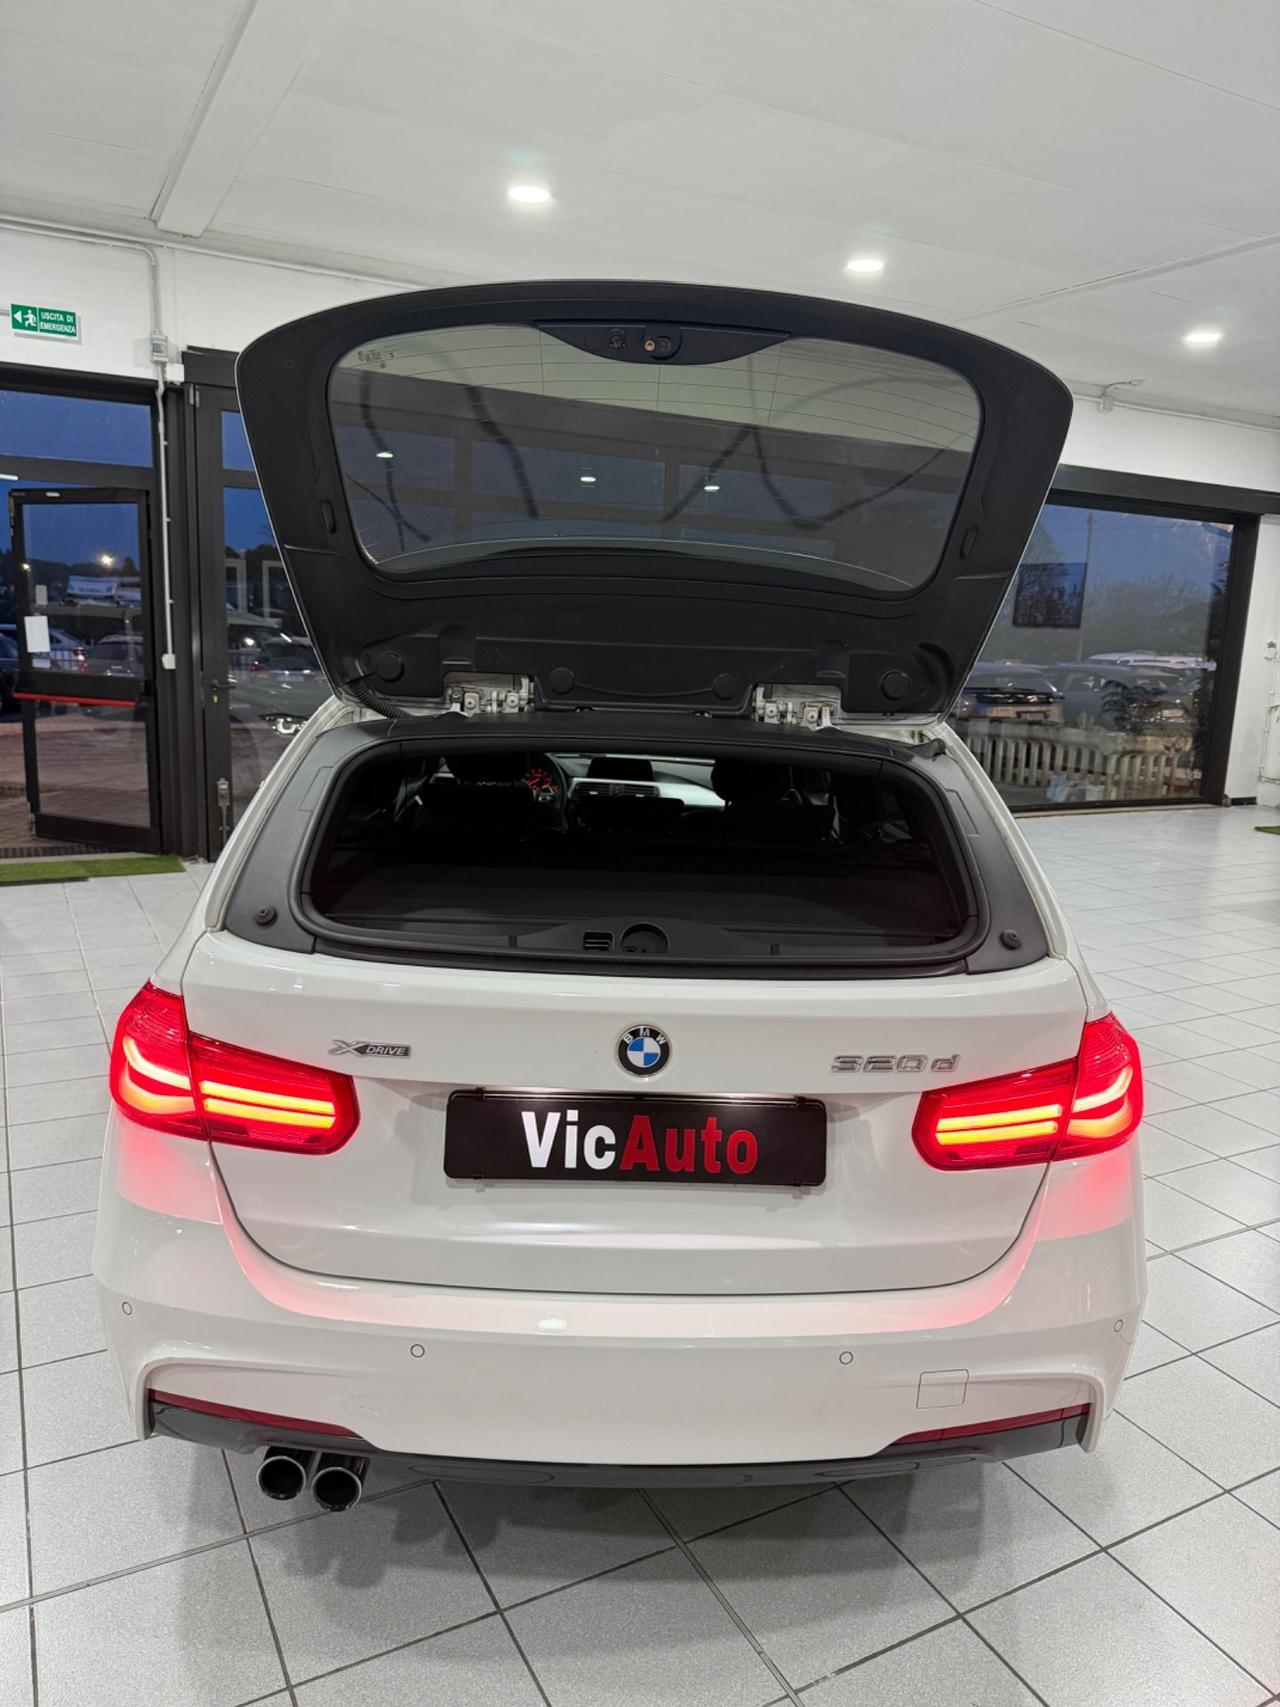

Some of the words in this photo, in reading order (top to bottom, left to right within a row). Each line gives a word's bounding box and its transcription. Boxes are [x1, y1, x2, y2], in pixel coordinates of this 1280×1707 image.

[41, 311, 64, 322] USCITA
[66, 314, 74, 323] DI
[40, 321, 76, 333] EMERGENZA
[623, 1027, 667, 1045] BMW
[831, 1054, 961, 1073] 320d
[521, 1109, 759, 1175] VicAuto
